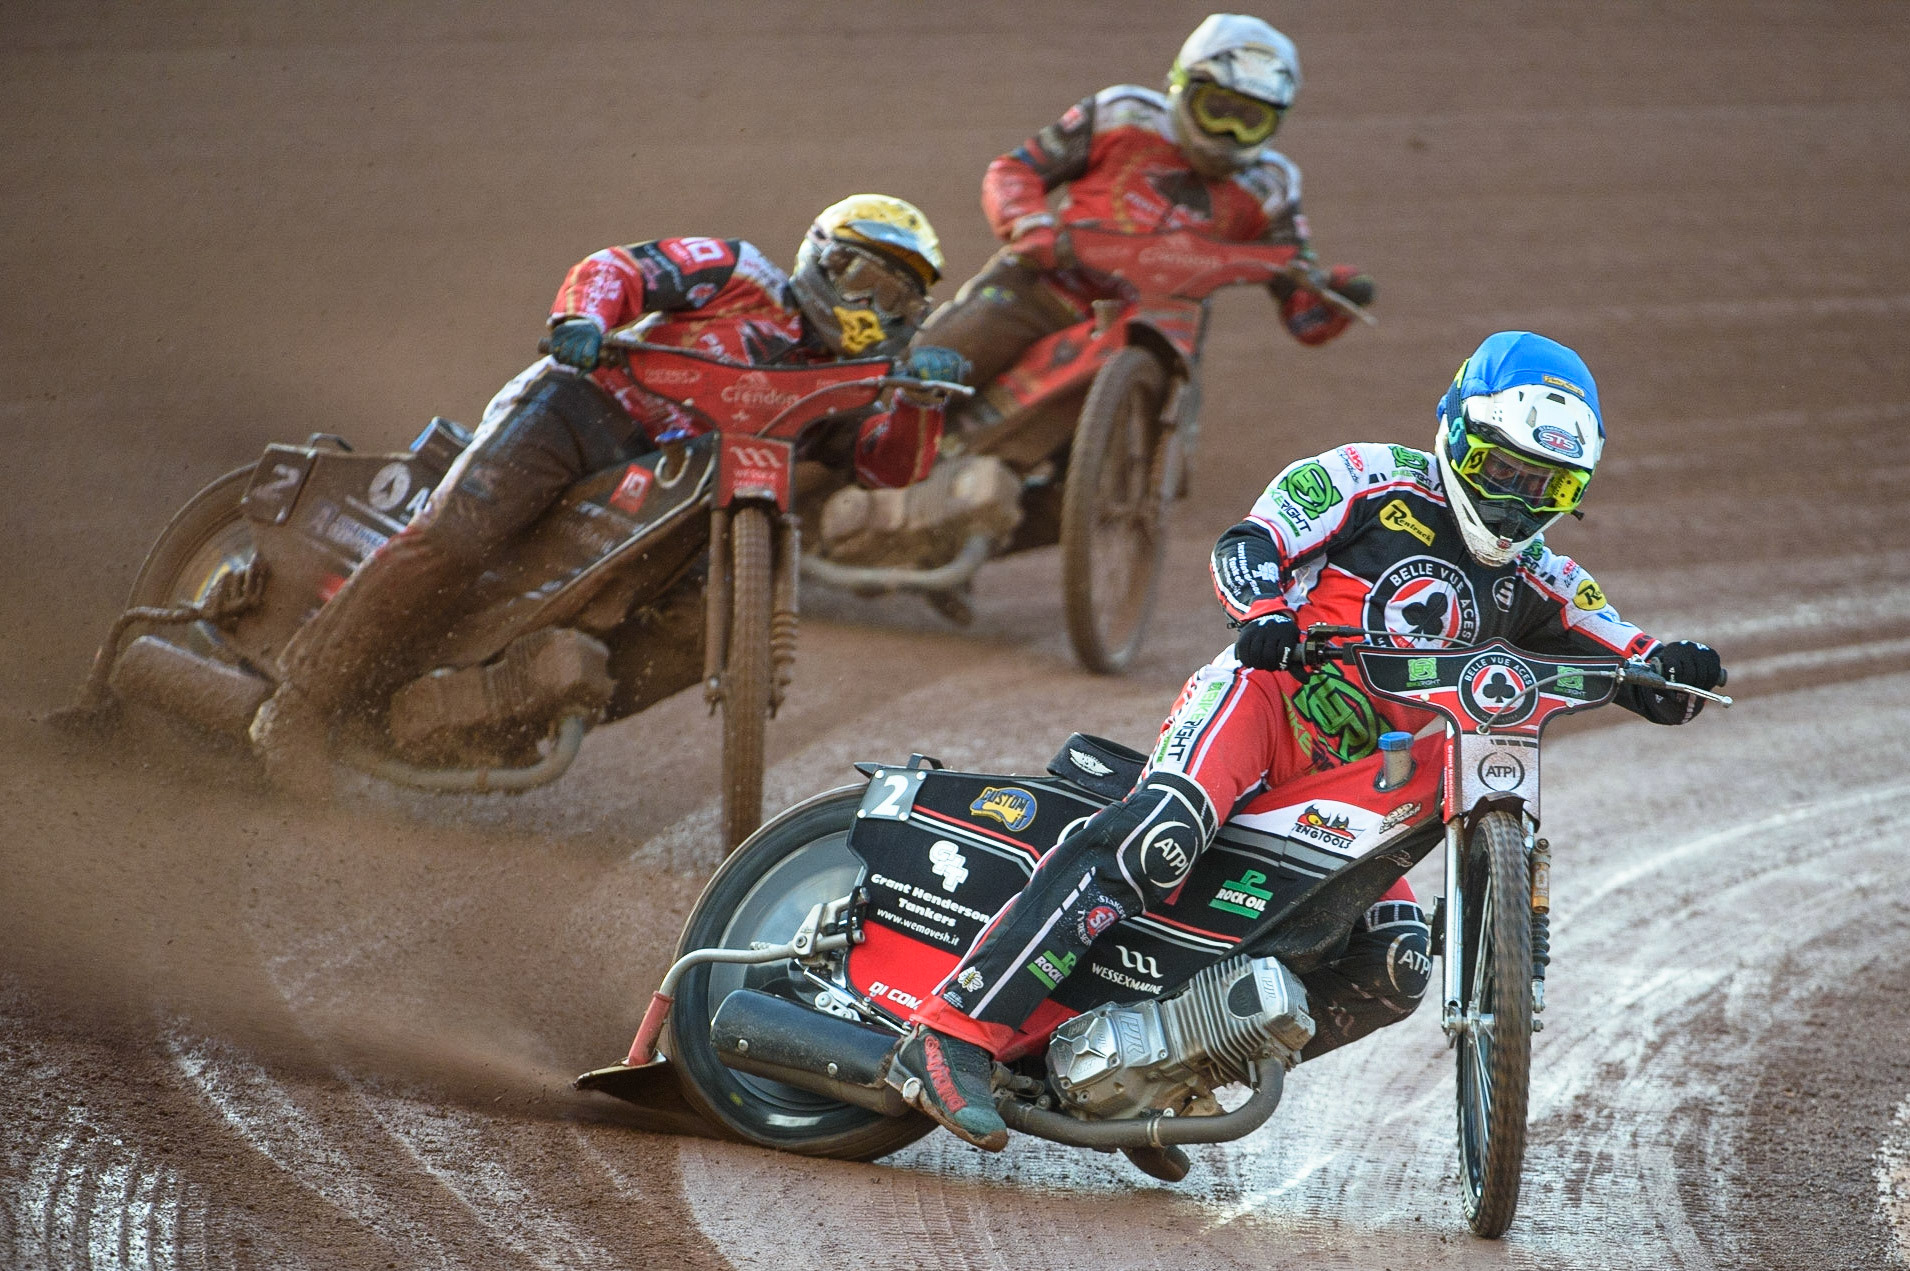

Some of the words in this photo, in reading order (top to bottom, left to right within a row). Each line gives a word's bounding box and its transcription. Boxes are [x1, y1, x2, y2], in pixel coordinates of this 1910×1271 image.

[1541, 432, 1575, 450] STS
[1384, 503, 1432, 542] Rentruck
[1389, 563, 1434, 587] BELLE
[1440, 567, 1465, 593] VUE
[1459, 599, 1475, 639] ACES
[1464, 658, 1488, 682] BELLE
[1490, 656, 1512, 666] VUE
[1512, 664, 1533, 686] ACES
[1485, 765, 1516, 779] ATPI
[870, 774, 909, 817] 2
[1153, 838, 1189, 876] ATPI
[871, 873, 912, 894] Grant
[911, 886, 991, 925] Henderson
[898, 897, 957, 928] Tankers
[1215, 888, 1248, 905] ROCK
[1245, 896, 1267, 912] OIL
